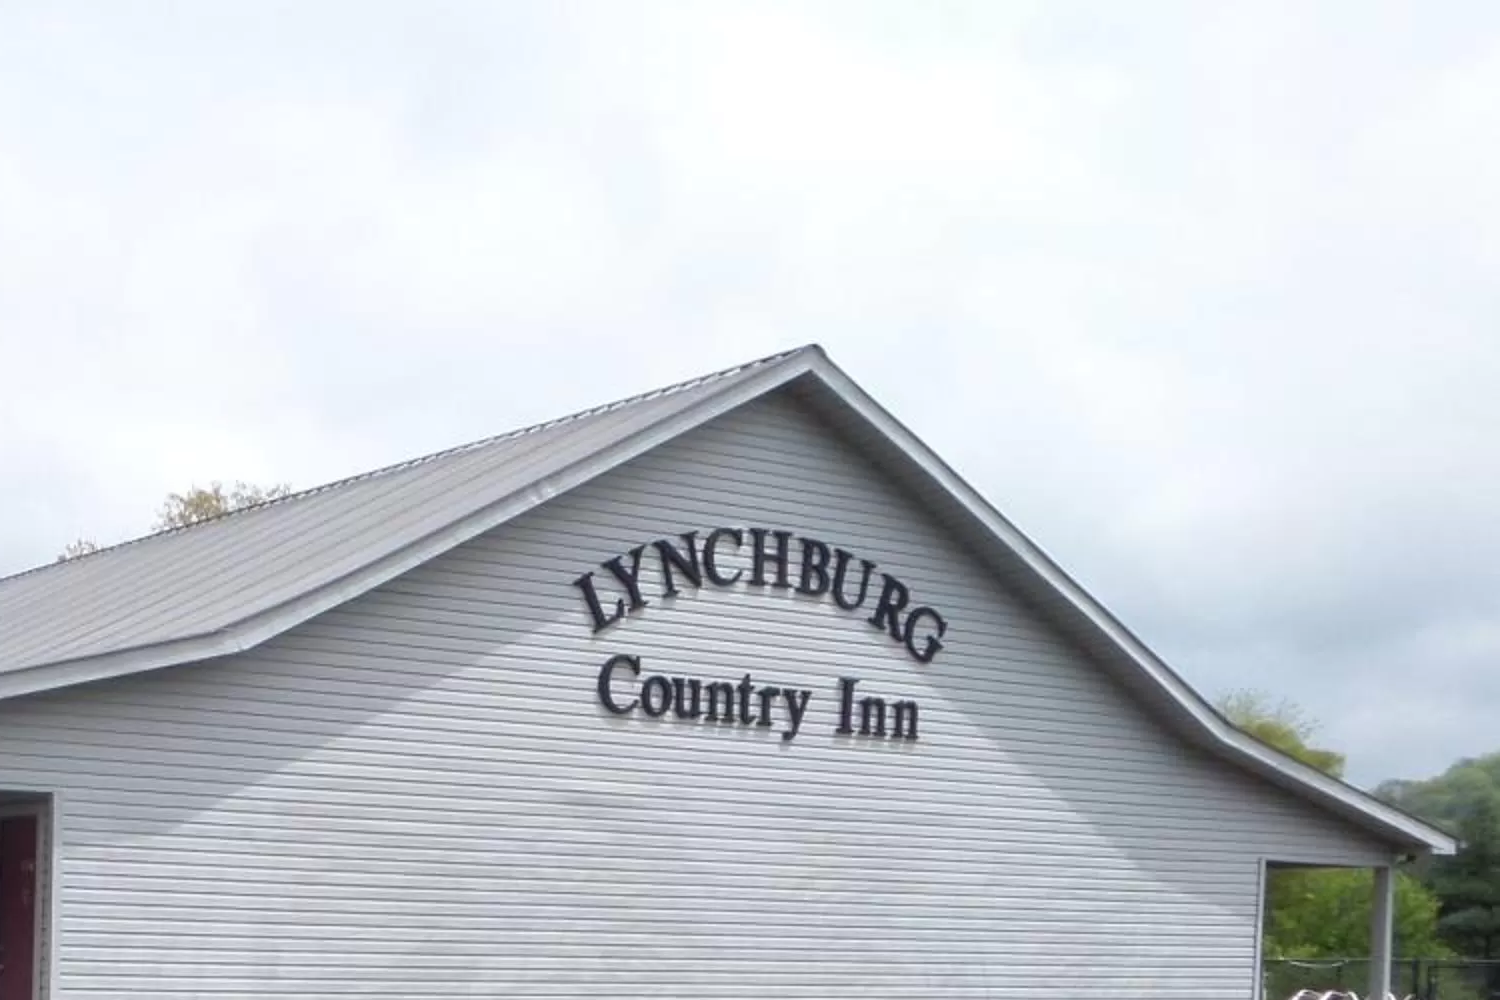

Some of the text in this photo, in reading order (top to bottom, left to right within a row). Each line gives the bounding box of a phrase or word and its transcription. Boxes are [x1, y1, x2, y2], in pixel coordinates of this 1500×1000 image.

[573, 527, 948, 664] LYNCHBURG
[598, 654, 919, 741] Country Inn
